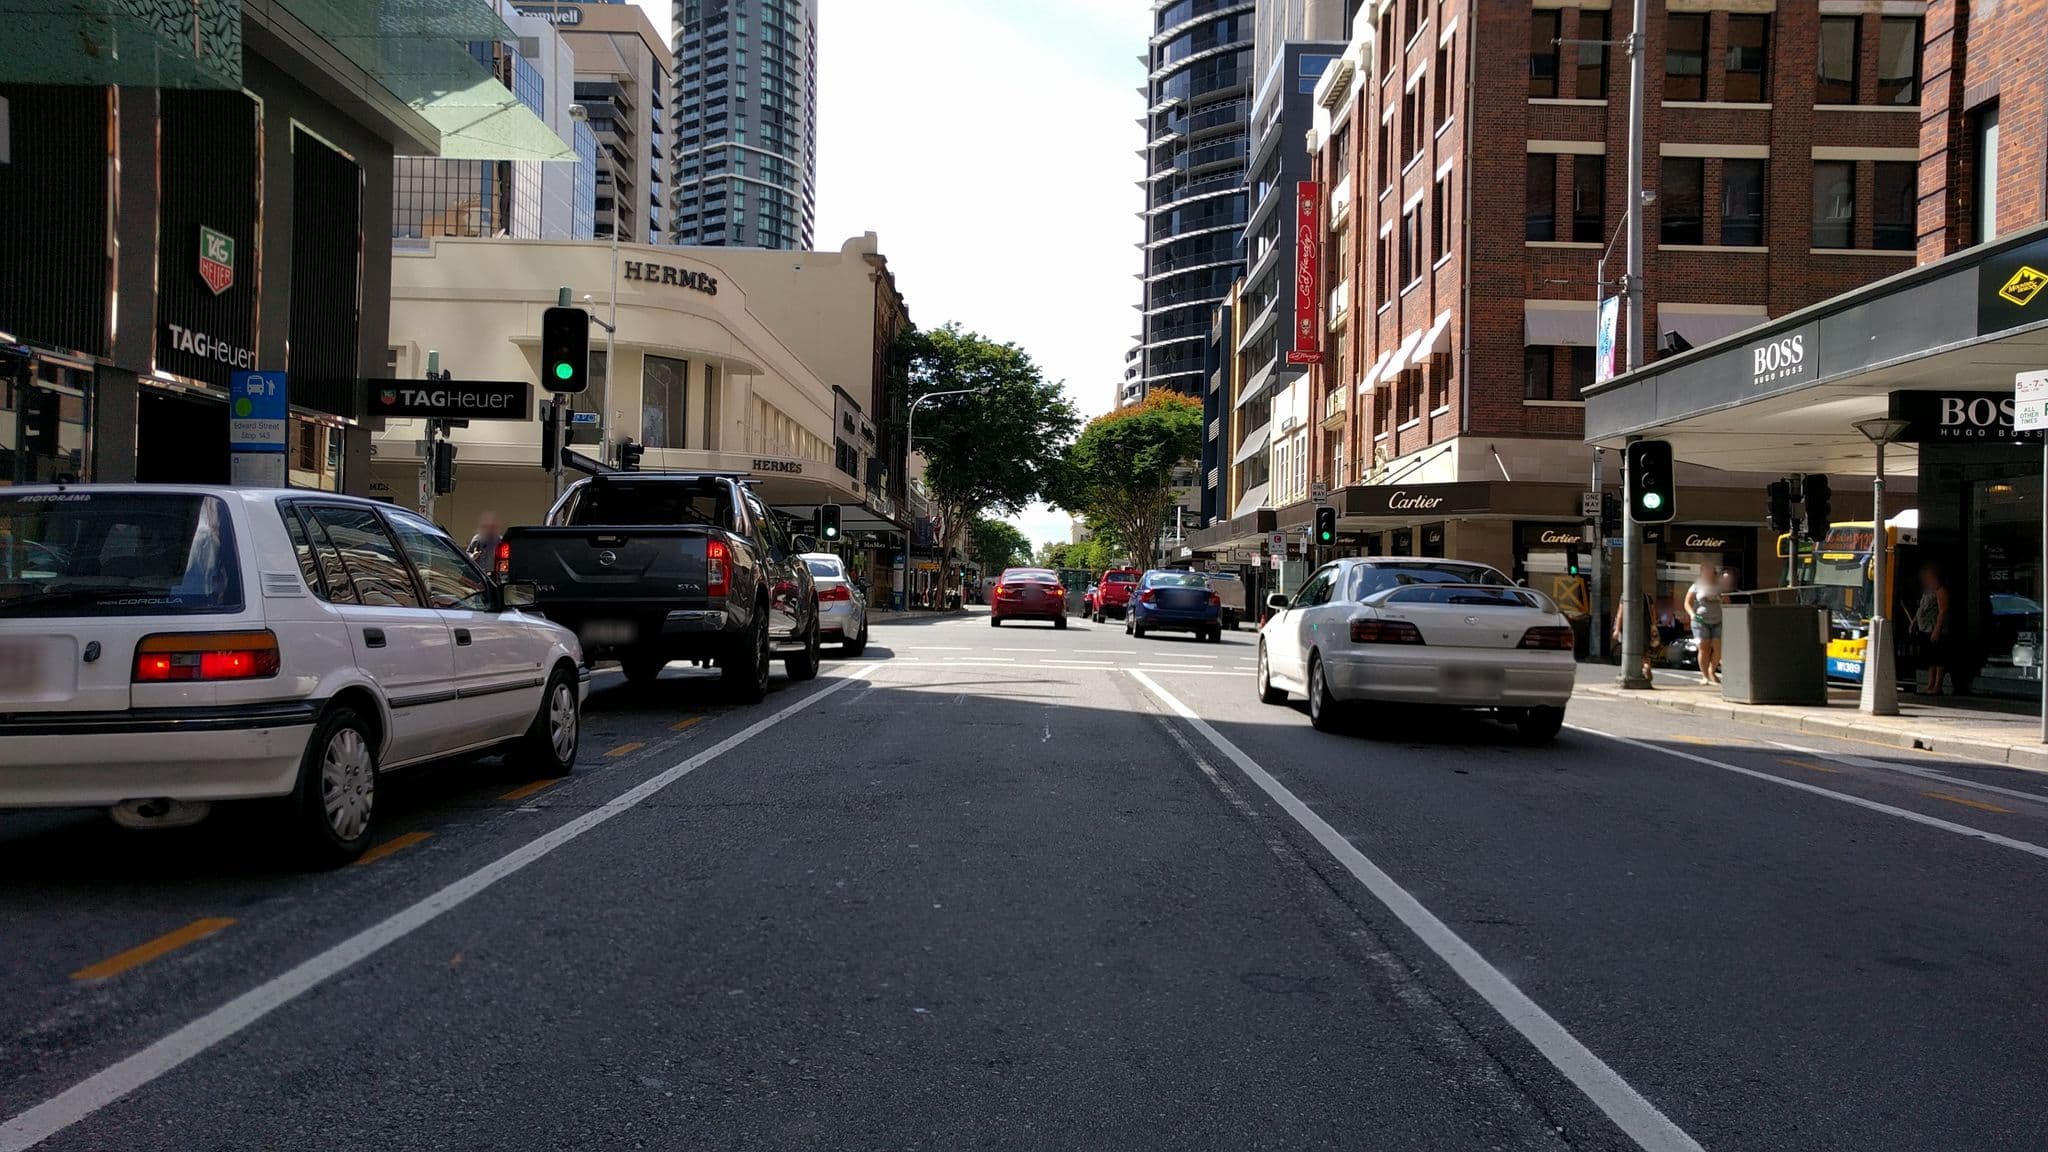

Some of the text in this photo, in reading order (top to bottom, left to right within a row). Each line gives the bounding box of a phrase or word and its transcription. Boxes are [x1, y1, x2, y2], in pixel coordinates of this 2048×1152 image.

[514, 8, 578, 23] mwell
[206, 234, 228, 262] TAG
[202, 260, 231, 290] HEUER
[1754, 335, 1803, 375] BOSS
[1754, 365, 1803, 385] HUGO BOSS
[400, 390, 514, 409] TAGHeuer
[1940, 397, 2016, 427] BOS
[1940, 428, 2043, 438] HUGO BOSS
[1388, 491, 1443, 509] Cartier
[1541, 530, 1581, 543] Cartier
[1685, 534, 1726, 547] Cartier
